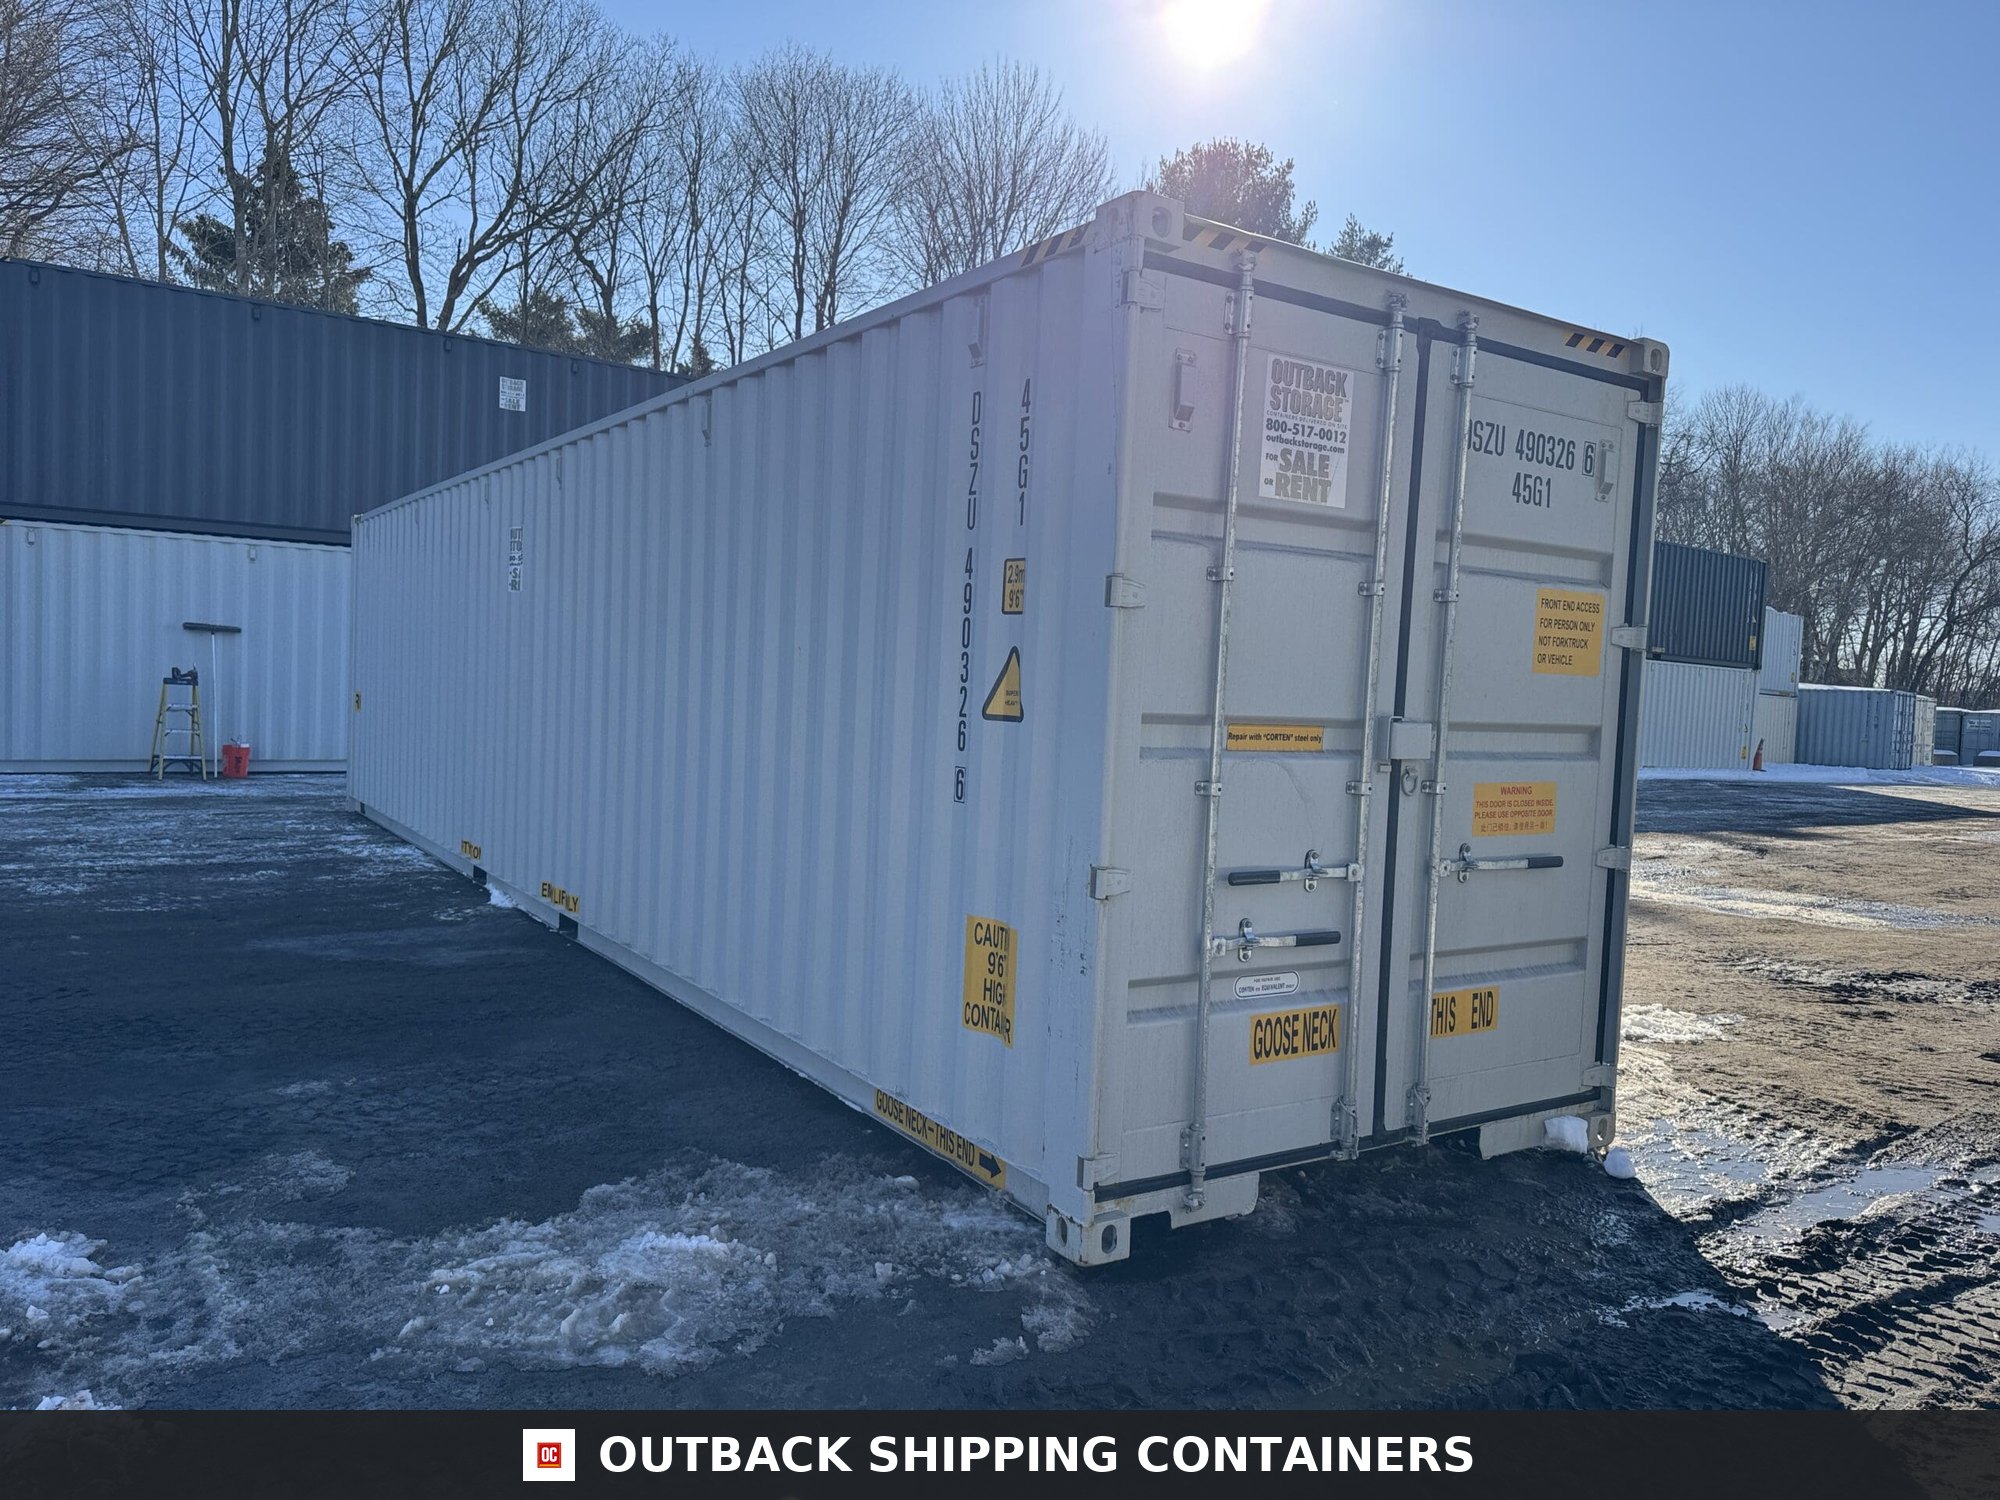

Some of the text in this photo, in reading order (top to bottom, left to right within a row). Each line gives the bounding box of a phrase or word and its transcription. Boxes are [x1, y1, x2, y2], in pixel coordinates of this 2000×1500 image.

[1271, 358, 1348, 398] OUTBACK
[1270, 385, 1343, 423] STORAGE
[1266, 418, 1347, 444] 800-517-0012
[1266, 434, 1345, 455] outbackstorage.com
[1018, 378, 1030, 526] 45G1
[1266, 448, 1330, 479] FOR SALE
[1515, 429, 1576, 471] 490326
[1583, 443, 1595, 475] 6
[1264, 472, 1332, 503] OR RENT
[1512, 472, 1552, 508] 45G1
[955, 391, 981, 801] DSZU 490326 6
[1541, 598, 1600, 614] FRONT END ACCESS
[1540, 618, 1595, 632] FOR PERSON ONLY
[1538, 636, 1589, 649] NOT FORKTRUCK
[1537, 653, 1573, 666] OR VEHICLE
[1228, 732, 1248, 742] Repair
[1249, 732, 1262, 740] with
[1294, 733, 1309, 742] steel
[1310, 734, 1322, 744] only
[1476, 800, 1489, 808] THIS
[1490, 800, 1505, 808] DOOR
[1501, 786, 1532, 796] WARNING
[1475, 811, 1496, 819] PLEASE
[1510, 810, 1536, 818] OPPOSITE
[1431, 991, 1494, 1035] THIS END
[1254, 1008, 1337, 1060] GOOSE NECK
[876, 1089, 904, 1124] GOOSE
[957, 1135, 975, 1167] END
